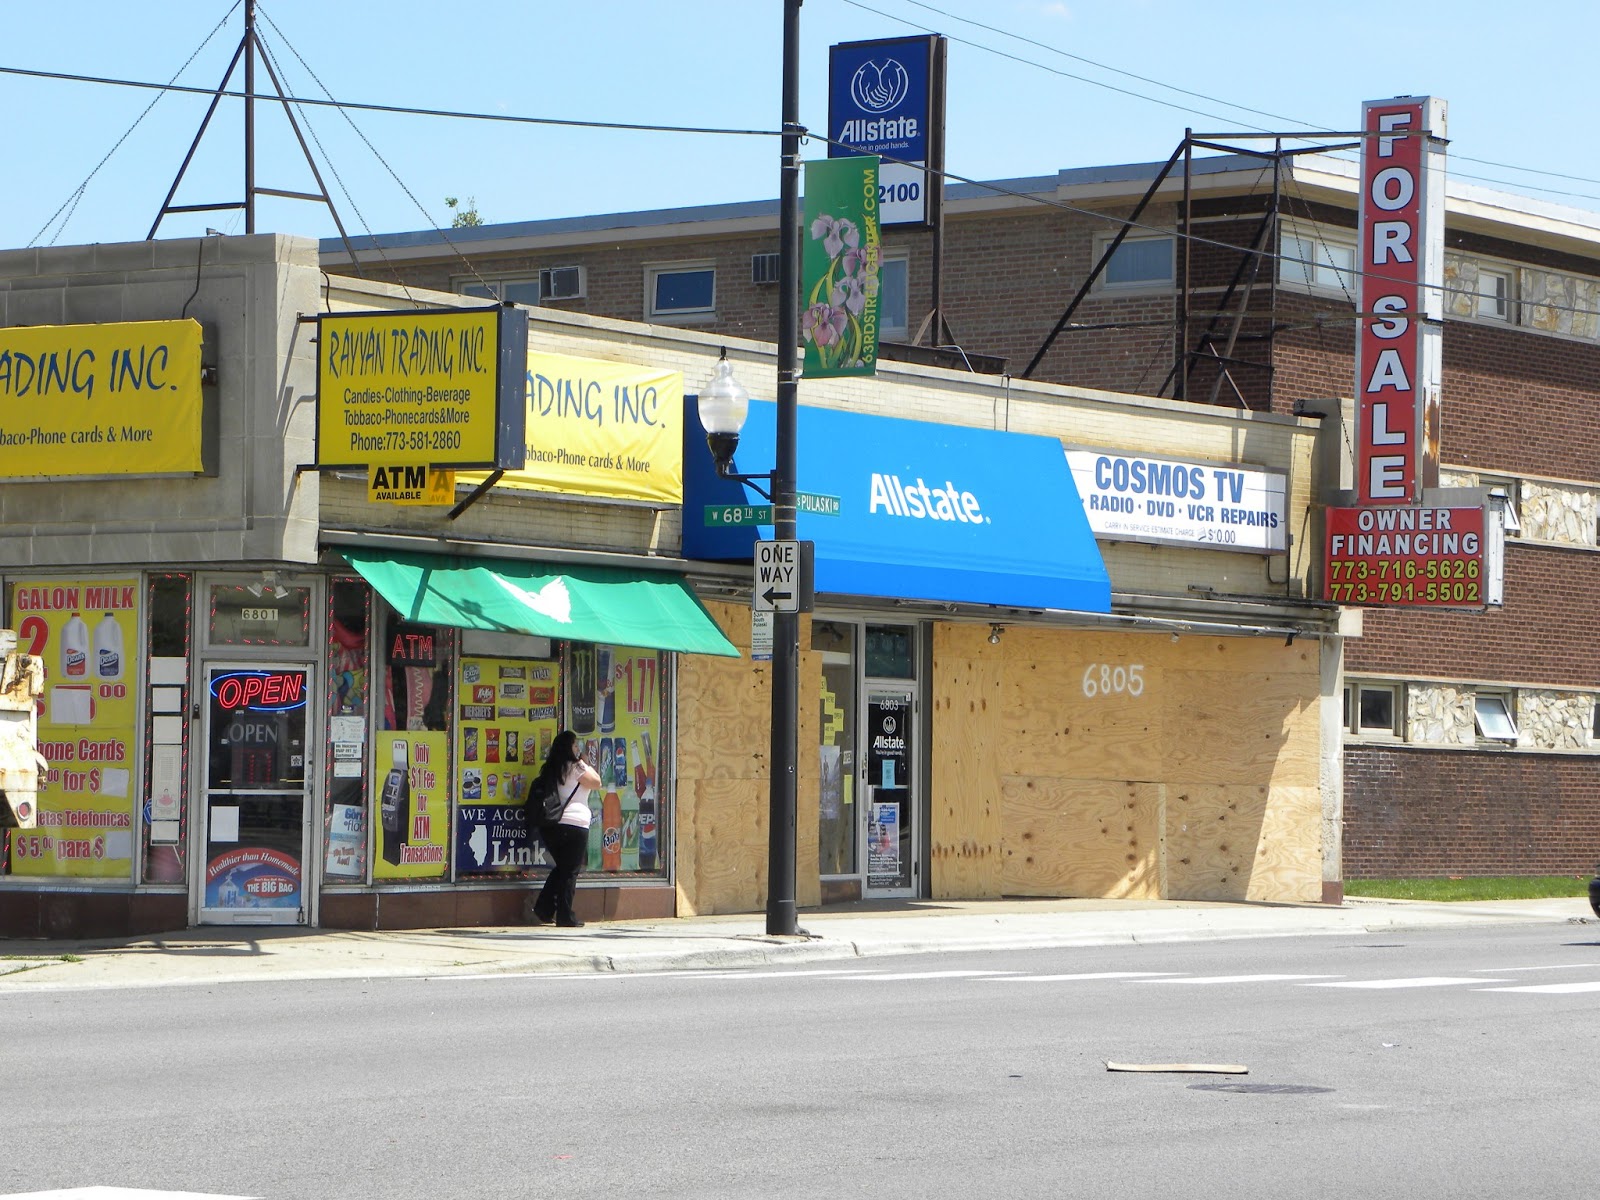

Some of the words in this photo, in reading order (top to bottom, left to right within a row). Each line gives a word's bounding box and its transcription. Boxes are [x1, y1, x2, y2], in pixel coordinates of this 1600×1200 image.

[838, 116, 919, 142] Allstate
[329, 327, 384, 379] RAYYAN
[391, 326, 454, 380] TRADING
[458, 326, 487, 374] INC.
[109, 345, 177, 392] INC.
[614, 384, 665, 428] INC.
[71, 426, 103, 443] cards
[107, 428, 117, 442] &
[120, 426, 153, 442] More
[589, 452, 613, 469] cards
[615, 458, 623, 470] &
[626, 456, 650, 472] More
[372, 466, 425, 489] ATM
[1095, 456, 1206, 501] COSMOS
[1213, 470, 1245, 504] TV
[376, 492, 421, 500] AVAILABLE
[801, 495, 833, 513] PULASKI
[833, 503, 839, 511] RD
[712, 512, 718, 520] W
[758, 510, 767, 520] ST
[1090, 494, 1134, 514] RADIO
[1146, 499, 1175, 518] DVD
[1187, 504, 1214, 522] VCR
[1221, 508, 1278, 529] REPAIRS
[1358, 509, 1451, 531] OWNER
[1331, 532, 1479, 556] FINANCING
[761, 547, 794, 563] ONE
[760, 566, 794, 583] WAY
[1330, 559, 1479, 580] 773-716-5626
[17, 588, 79, 611] GALON
[85, 586, 135, 609] MILK
[1330, 582, 1479, 602] 773-791-5502
[243, 609, 276, 620] 6801
[391, 634, 433, 661] ATM
[1083, 663, 1144, 698] 6805
[219, 674, 302, 709] OPEN
[880, 699, 898, 711] 6803
[229, 724, 278, 743] OPEN
[873, 735, 905, 749] Allstate
[78, 738, 125, 761] Cards
[415, 742, 430, 764] Only
[63, 771, 86, 791] for
[89, 768, 100, 793] $
[424, 768, 435, 789] Fee
[417, 792, 427, 812] for
[65, 810, 130, 827] Telefonicas
[461, 809, 486, 821] WE
[413, 815, 430, 840] ATM
[492, 824, 527, 838] Illinois
[57, 839, 91, 860] para
[401, 843, 443, 863] Transactions
[491, 840, 547, 866] Link
[209, 855, 241, 876] Healthier
[242, 853, 259, 861] than
[261, 853, 299, 876] Homemade
[247, 884, 259, 892] THE
[261, 881, 277, 893] BIG
[278, 883, 293, 893] BAG
